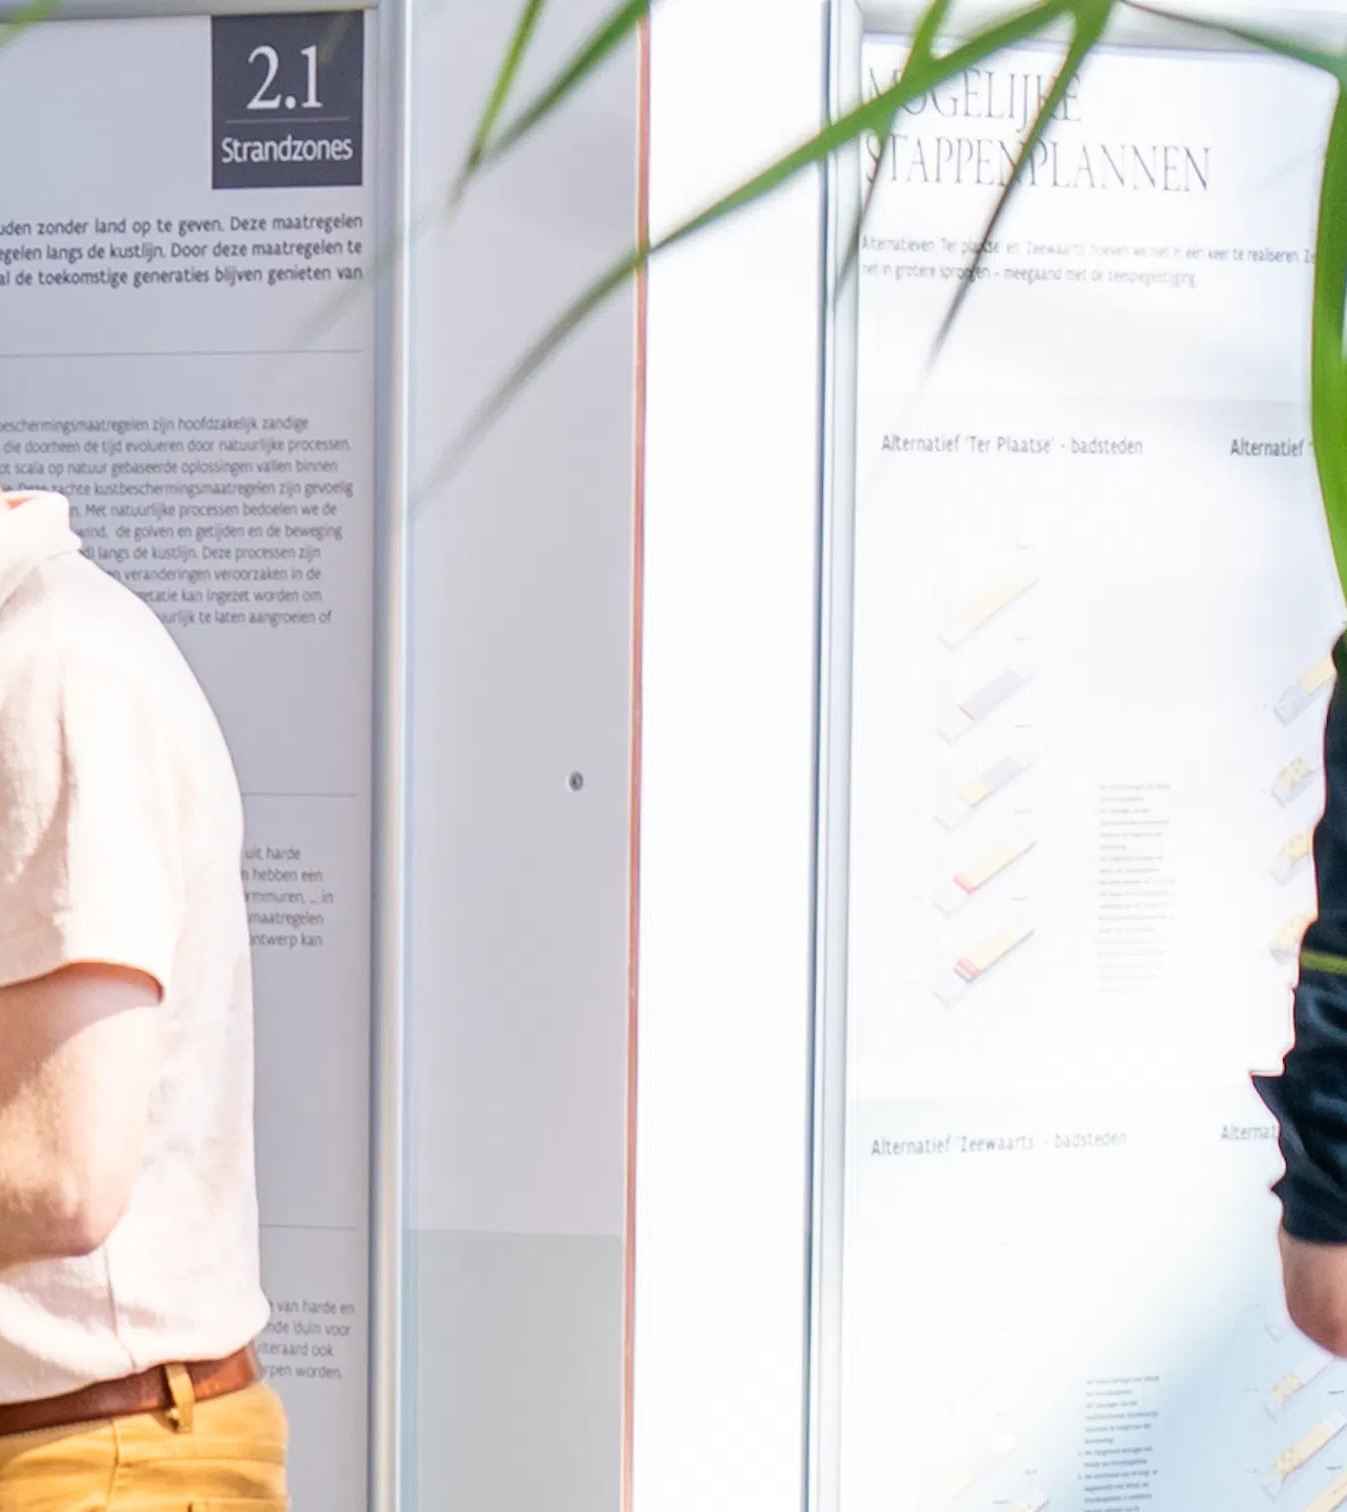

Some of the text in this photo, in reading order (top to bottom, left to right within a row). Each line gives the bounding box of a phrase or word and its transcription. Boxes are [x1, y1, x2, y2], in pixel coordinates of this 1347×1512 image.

[247, 44, 323, 110] 2.1
[221, 134, 354, 164] Strandzones
[37, 218, 88, 235] zonder
[95, 217, 127, 234] land
[132, 221, 151, 237] op
[157, 218, 172, 233] te
[179, 220, 225, 237] geven.
[230, 215, 267, 231] Deze
[273, 212, 363, 234] maatregelen
[47, 243, 83, 264] langs
[87, 243, 104, 259] de
[110, 242, 165, 263] kustlijn.
[171, 241, 207, 258] Door
[212, 240, 247, 257] deze
[252, 238, 342, 260] maatregelen
[347, 240, 363, 254] te
[15, 269, 32, 285] de
[38, 267, 128, 288] toekomstige
[133, 266, 209, 288] generaties
[215, 265, 262, 286] blijven
[268, 264, 331, 285] genieten
[336, 267, 363, 280] van
[152, 416, 175, 435] zijn
[178, 416, 258, 435] hoofdzakelijk
[262, 416, 309, 434] zandige
[3, 439, 21, 453] die
[25, 438, 80, 453] doorheen
[84, 438, 99, 453] de
[101, 438, 122, 457] tijd
[125, 438, 183, 452] evolueren
[187, 437, 214, 452] door
[218, 437, 284, 456] natuurlijke
[881, 434, 959, 453] Alternatief
[1071, 438, 1143, 457] badsteden
[1231, 438, 1305, 458] Alternatief
[14, 460, 45, 475] scala
[48, 464, 64, 479] op
[67, 461, 107, 474] natuur
[111, 459, 177, 478] gebaseerde
[181, 459, 253, 478] oplossingen
[257, 458, 292, 473] vallen
[296, 458, 338, 473] binnen
[279, 480, 301, 498] zijn
[305, 479, 354, 498] gevoelig
[85, 503, 107, 517] Met
[111, 502, 175, 521] natuurlijke
[179, 506, 239, 521] processen
[243, 502, 297, 517] bedoelen
[302, 505, 319, 516] we
[322, 502, 337, 516] de
[115, 524, 131, 538] de
[135, 524, 174, 542] golven
[178, 527, 192, 538] en
[248, 527, 263, 538] en
[267, 523, 281, 538] de
[284, 523, 343, 542] beweging
[98, 546, 130, 564] langs
[133, 546, 148, 560] de
[202, 545, 231, 560] Deze
[235, 549, 296, 564] processen
[299, 545, 321, 564] zijn
[124, 566, 211, 585] veranderingen
[214, 566, 288, 581] veroorzaken
[291, 566, 303, 581] in
[306, 566, 321, 581] de
[181, 588, 203, 602] kan
[254, 588, 299, 602] worden
[302, 591, 322, 602] om
[198, 611, 211, 624] te
[215, 610, 245, 624] laten
[249, 610, 315, 628] aangroeien
[318, 609, 333, 624] of
